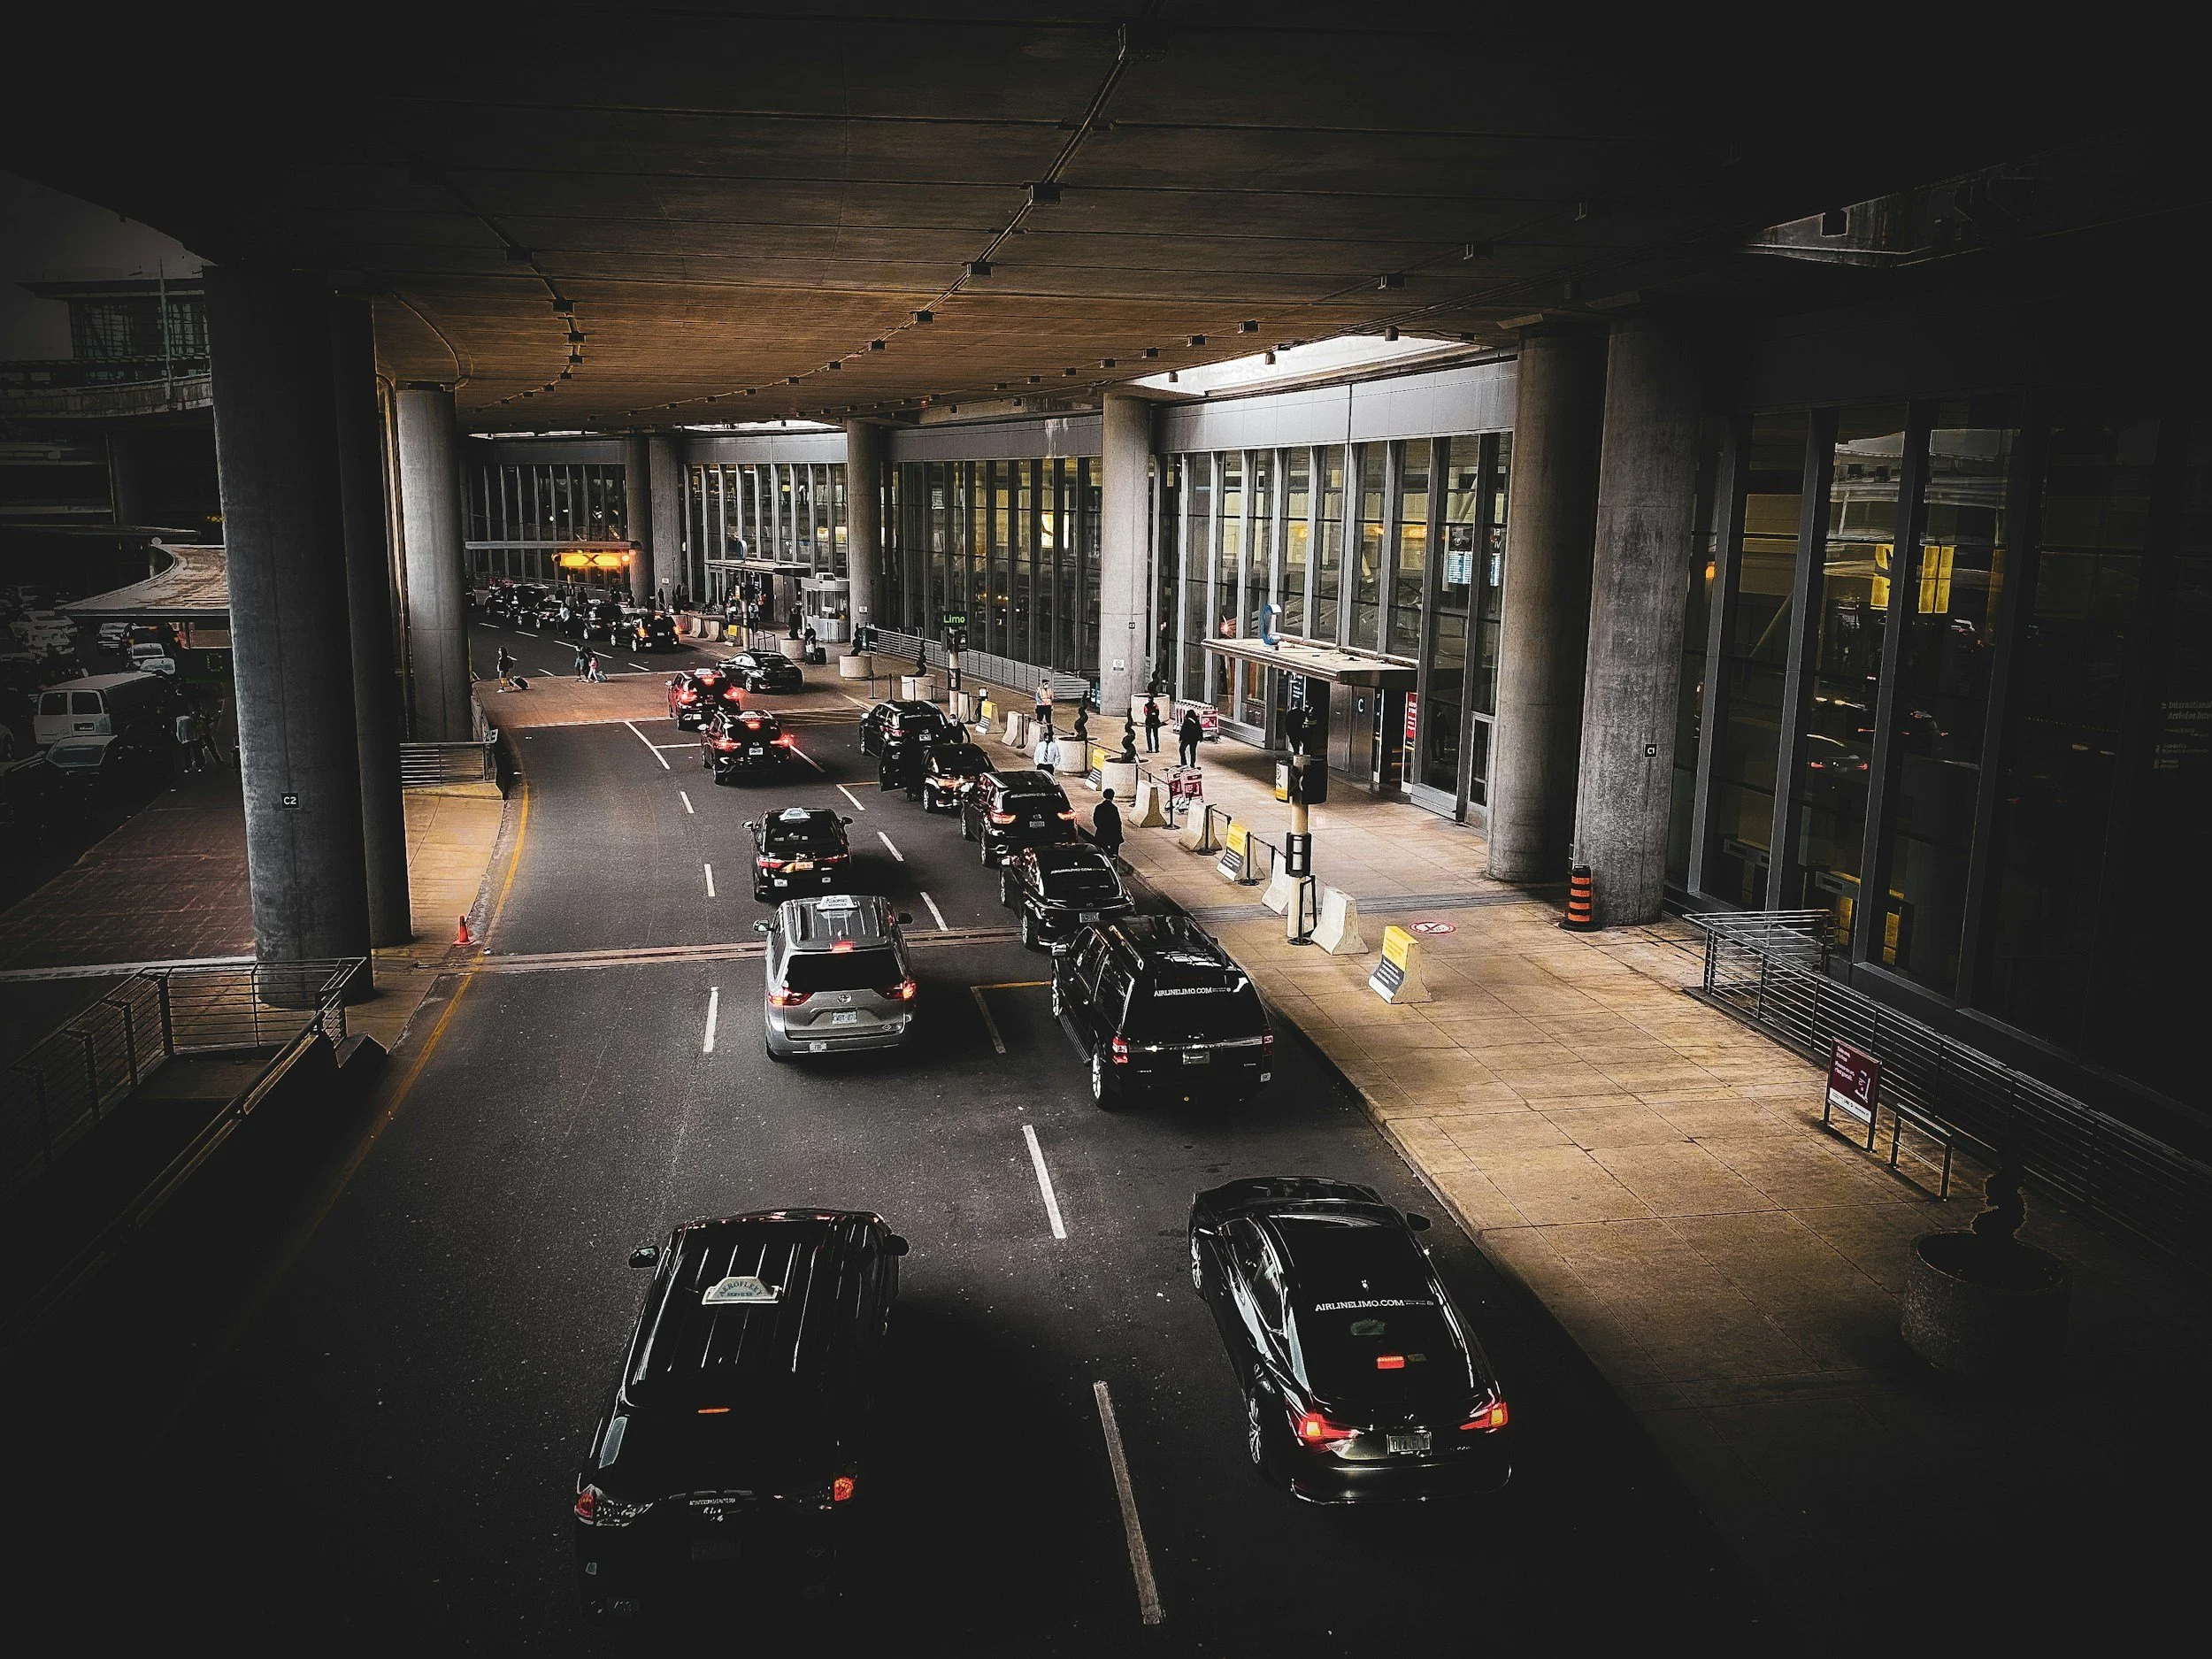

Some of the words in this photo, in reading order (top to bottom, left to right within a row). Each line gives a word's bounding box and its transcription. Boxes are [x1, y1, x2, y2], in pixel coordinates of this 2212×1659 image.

[943, 614, 965, 623] Limo
[1357, 699, 1364, 712] C
[283, 796, 297, 805] C2
[1154, 987, 1212, 997] AIRLINELIMO.COM
[1315, 1299, 1405, 1311] AIRLINELIMO.COM
